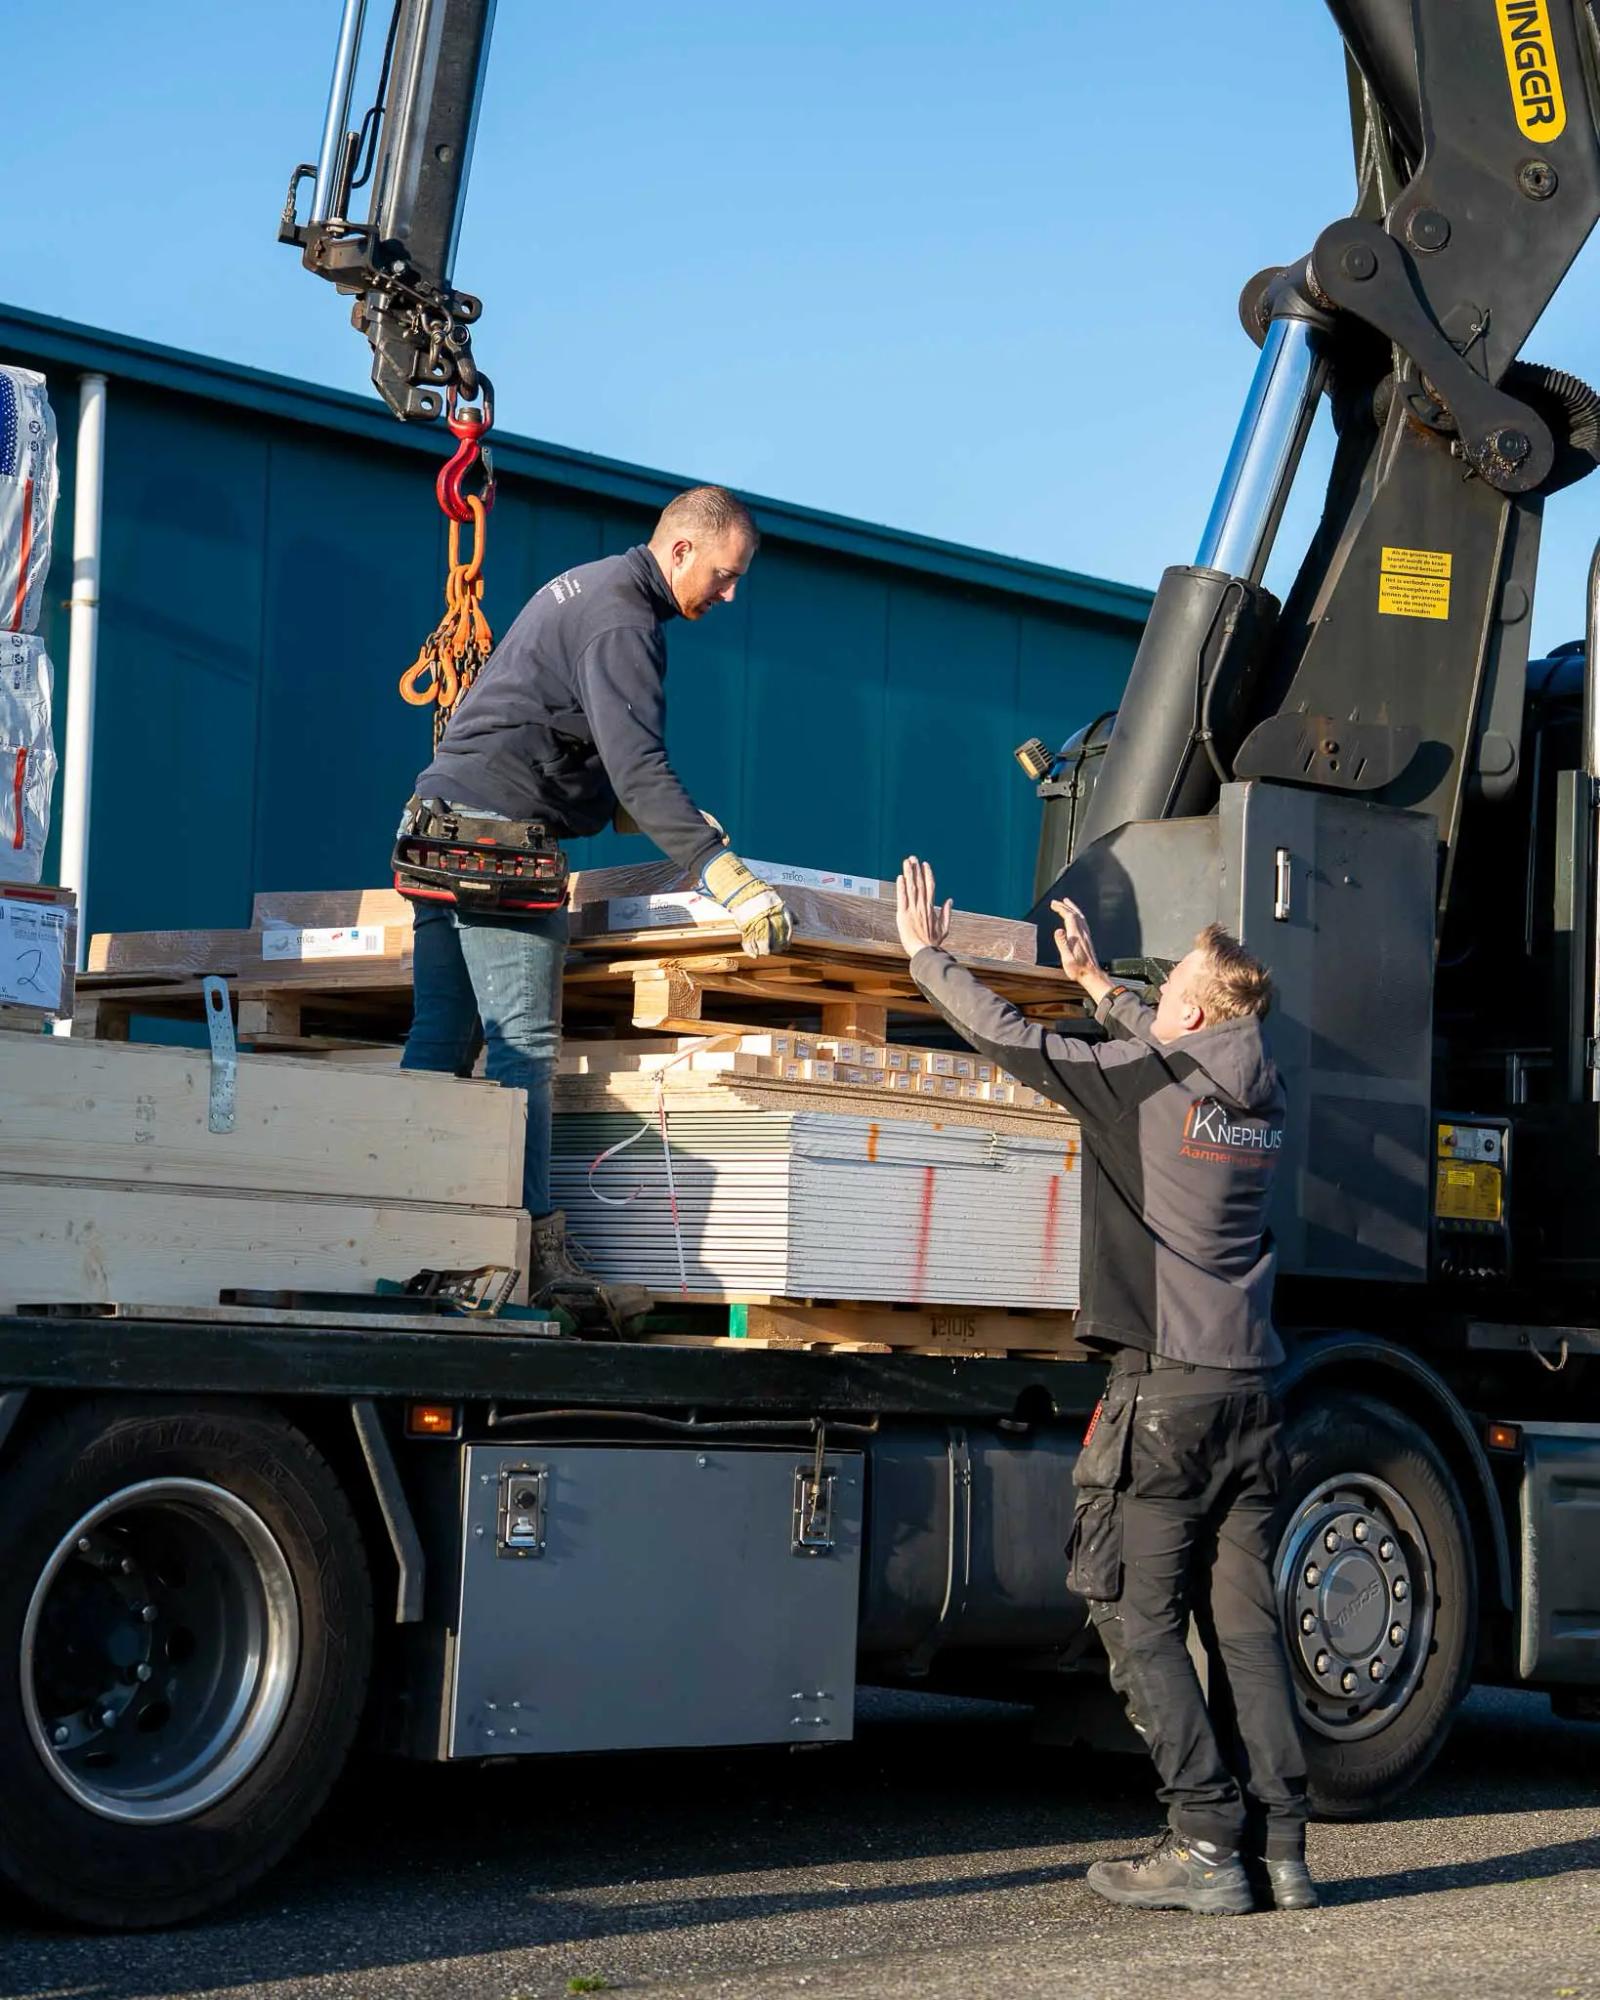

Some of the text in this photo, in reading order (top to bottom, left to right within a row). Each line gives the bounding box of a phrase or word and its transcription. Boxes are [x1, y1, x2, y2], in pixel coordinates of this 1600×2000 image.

[1506, 0, 1556, 127] INGER
[16, 949, 47, 993] 2
[1191, 1106, 1282, 1148] KNEPHUIS
